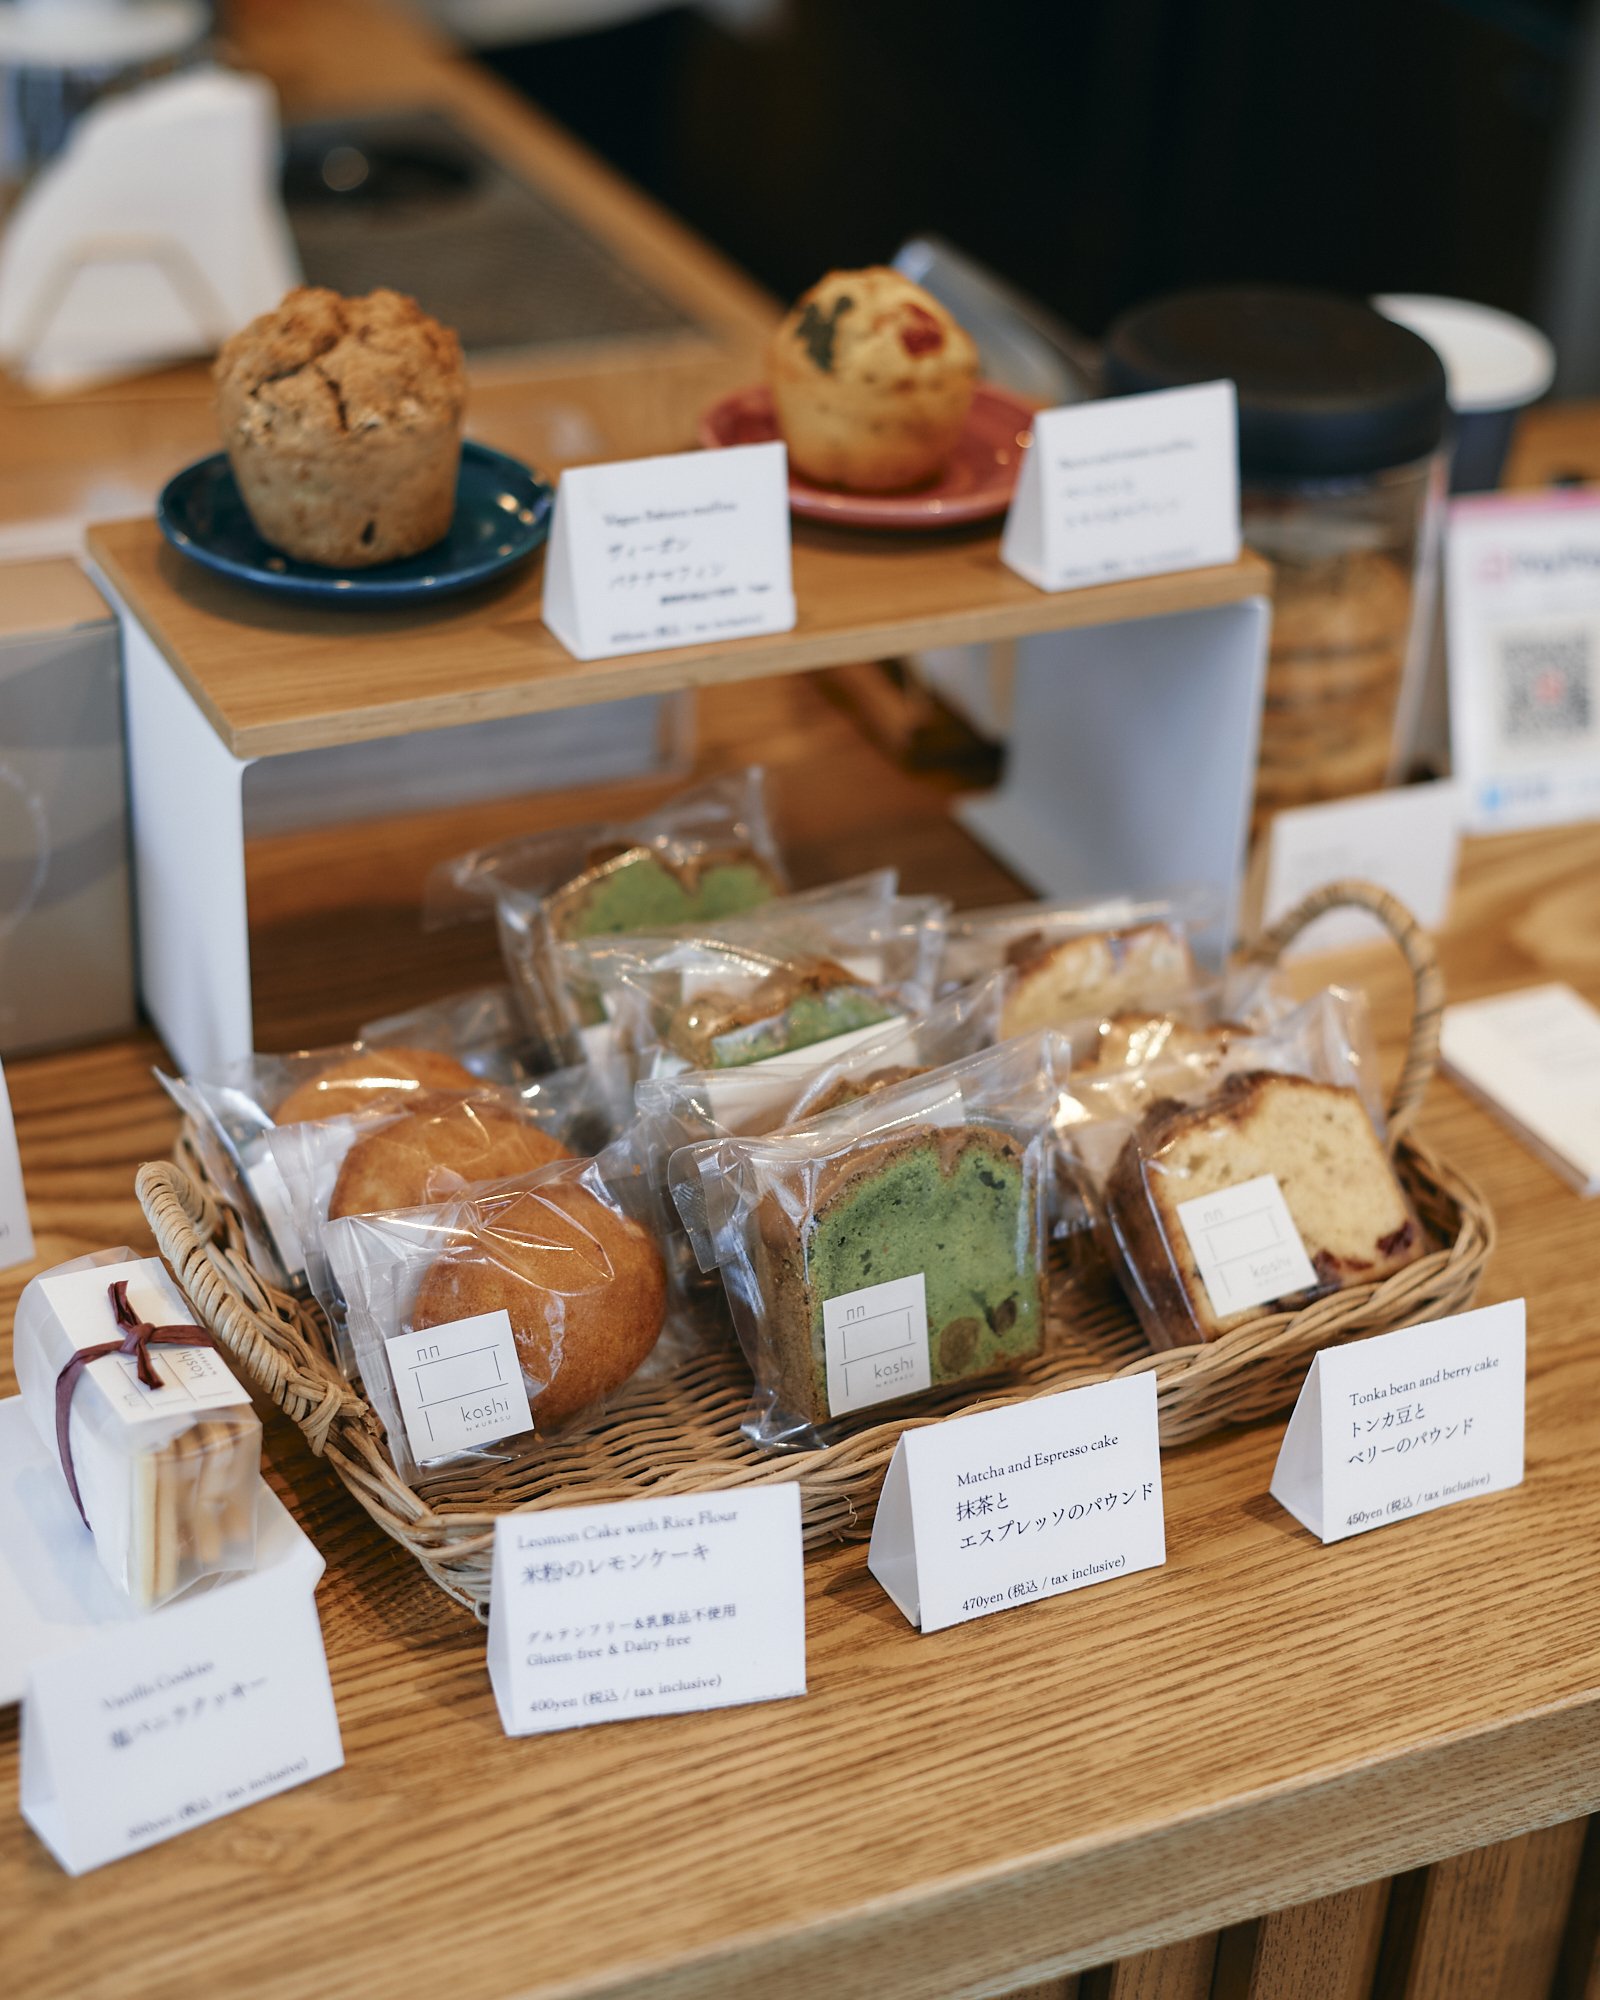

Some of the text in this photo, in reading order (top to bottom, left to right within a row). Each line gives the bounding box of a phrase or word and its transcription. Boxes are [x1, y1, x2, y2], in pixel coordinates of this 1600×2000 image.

[874, 1356, 914, 1379] kashi
[1349, 1356, 1499, 1407] Tonka bean and berry cake
[461, 1398, 509, 1422] kashi
[1352, 1403, 1426, 1438] トンカ豆と
[957, 1435, 1119, 1487] Matcha and Espresso cake
[1347, 1417, 1474, 1465] ベリーのパウンド
[956, 1492, 1009, 1522] 抹茶と
[959, 1482, 1153, 1550] エスプレッソのパウンド
[1346, 1509, 1383, 1527] 450yen
[1424, 1489, 1439, 1502] tax
[1442, 1473, 1491, 1497] inclusive)
[583, 1523, 620, 1540] Cake
[626, 1518, 659, 1534] with
[662, 1515, 694, 1530] Rice
[698, 1509, 738, 1525] Flour
[522, 1543, 709, 1585] 米粉のレモンケーキ
[962, 1592, 1004, 1612] 470yen
[1051, 1574, 1068, 1586] tax
[1072, 1555, 1126, 1580] inclusive)
[527, 1647, 602, 1666] Gluten-free
[624, 1635, 691, 1653] Dairy-free
[529, 1698, 578, 1713] 400yen
[634, 1687, 654, 1698] tax
[659, 1674, 722, 1694] inclusive)
